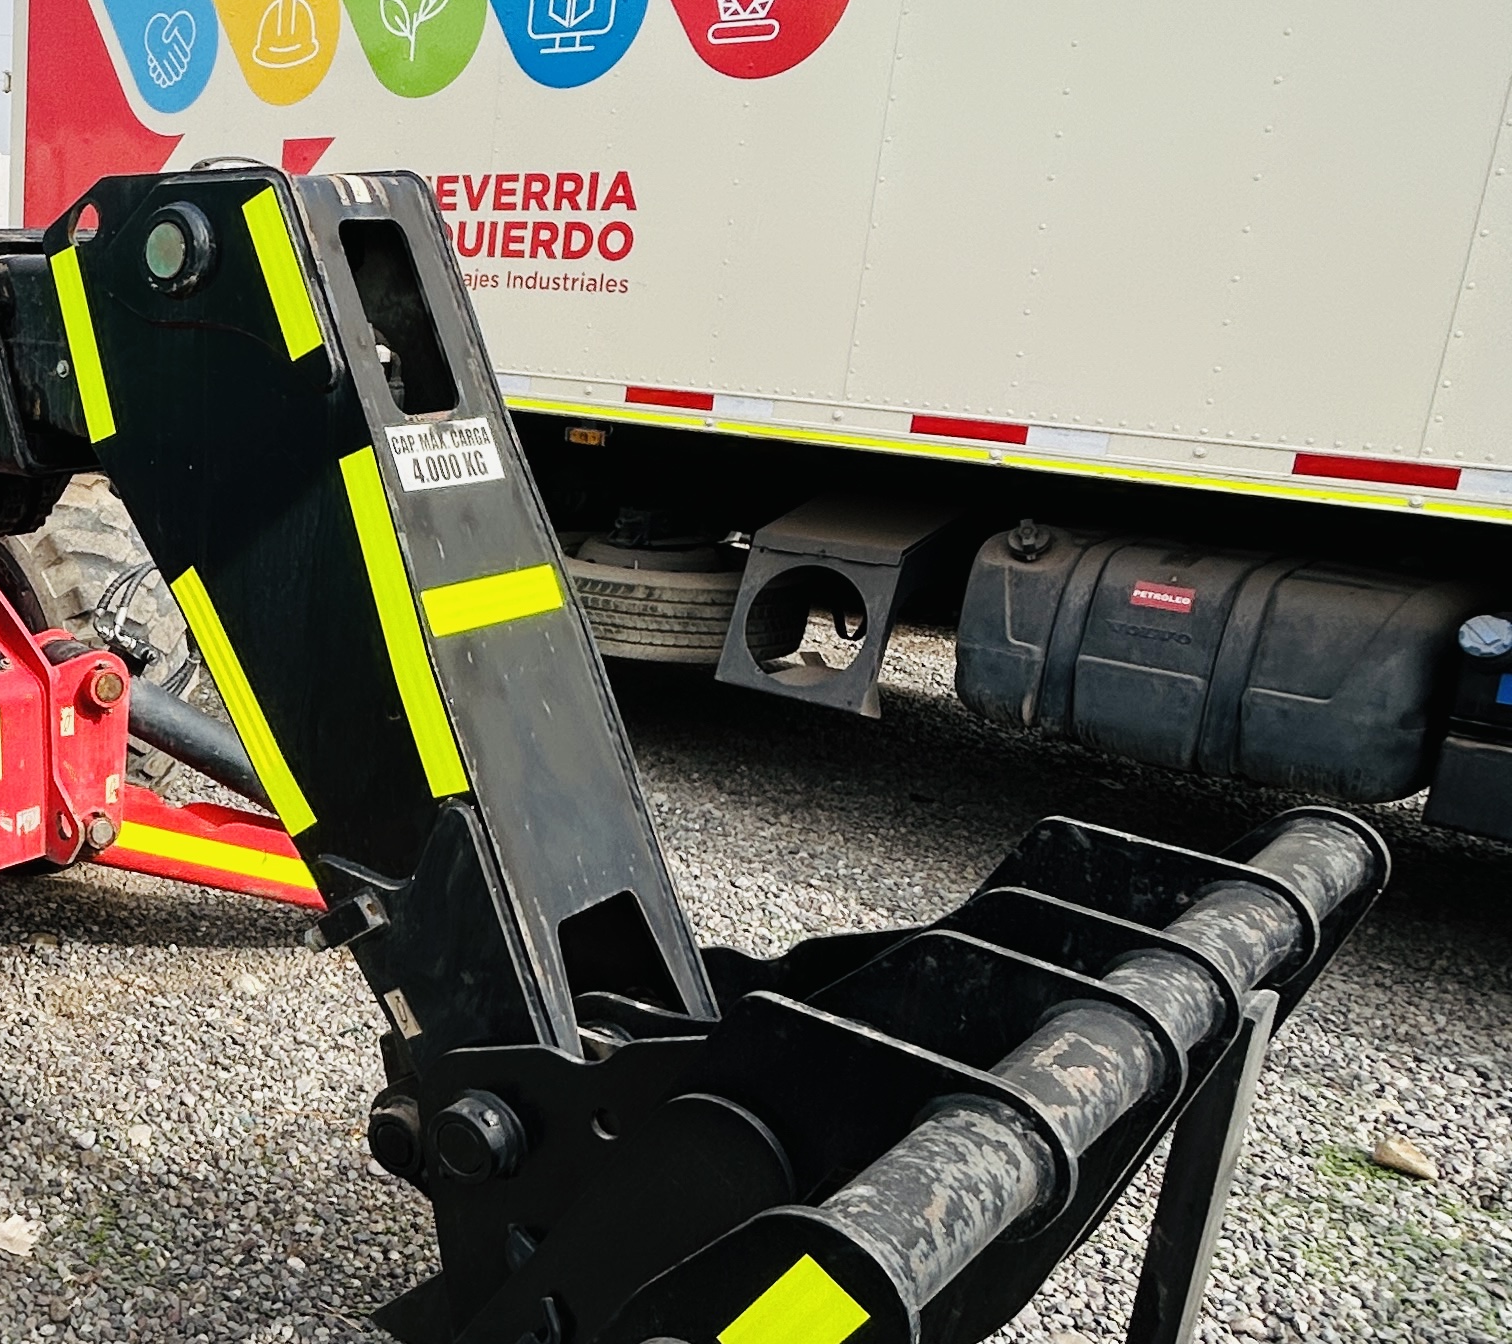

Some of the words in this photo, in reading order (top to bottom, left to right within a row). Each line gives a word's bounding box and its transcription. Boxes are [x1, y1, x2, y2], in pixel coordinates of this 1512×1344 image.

[426, 171, 637, 211] EVERRIA
[506, 270, 629, 293] Industriales
[450, 426, 491, 448] CARGA
[412, 454, 462, 484] 4.000
[462, 450, 489, 477] KG
[1132, 589, 1192, 605] PETRÓLEO
